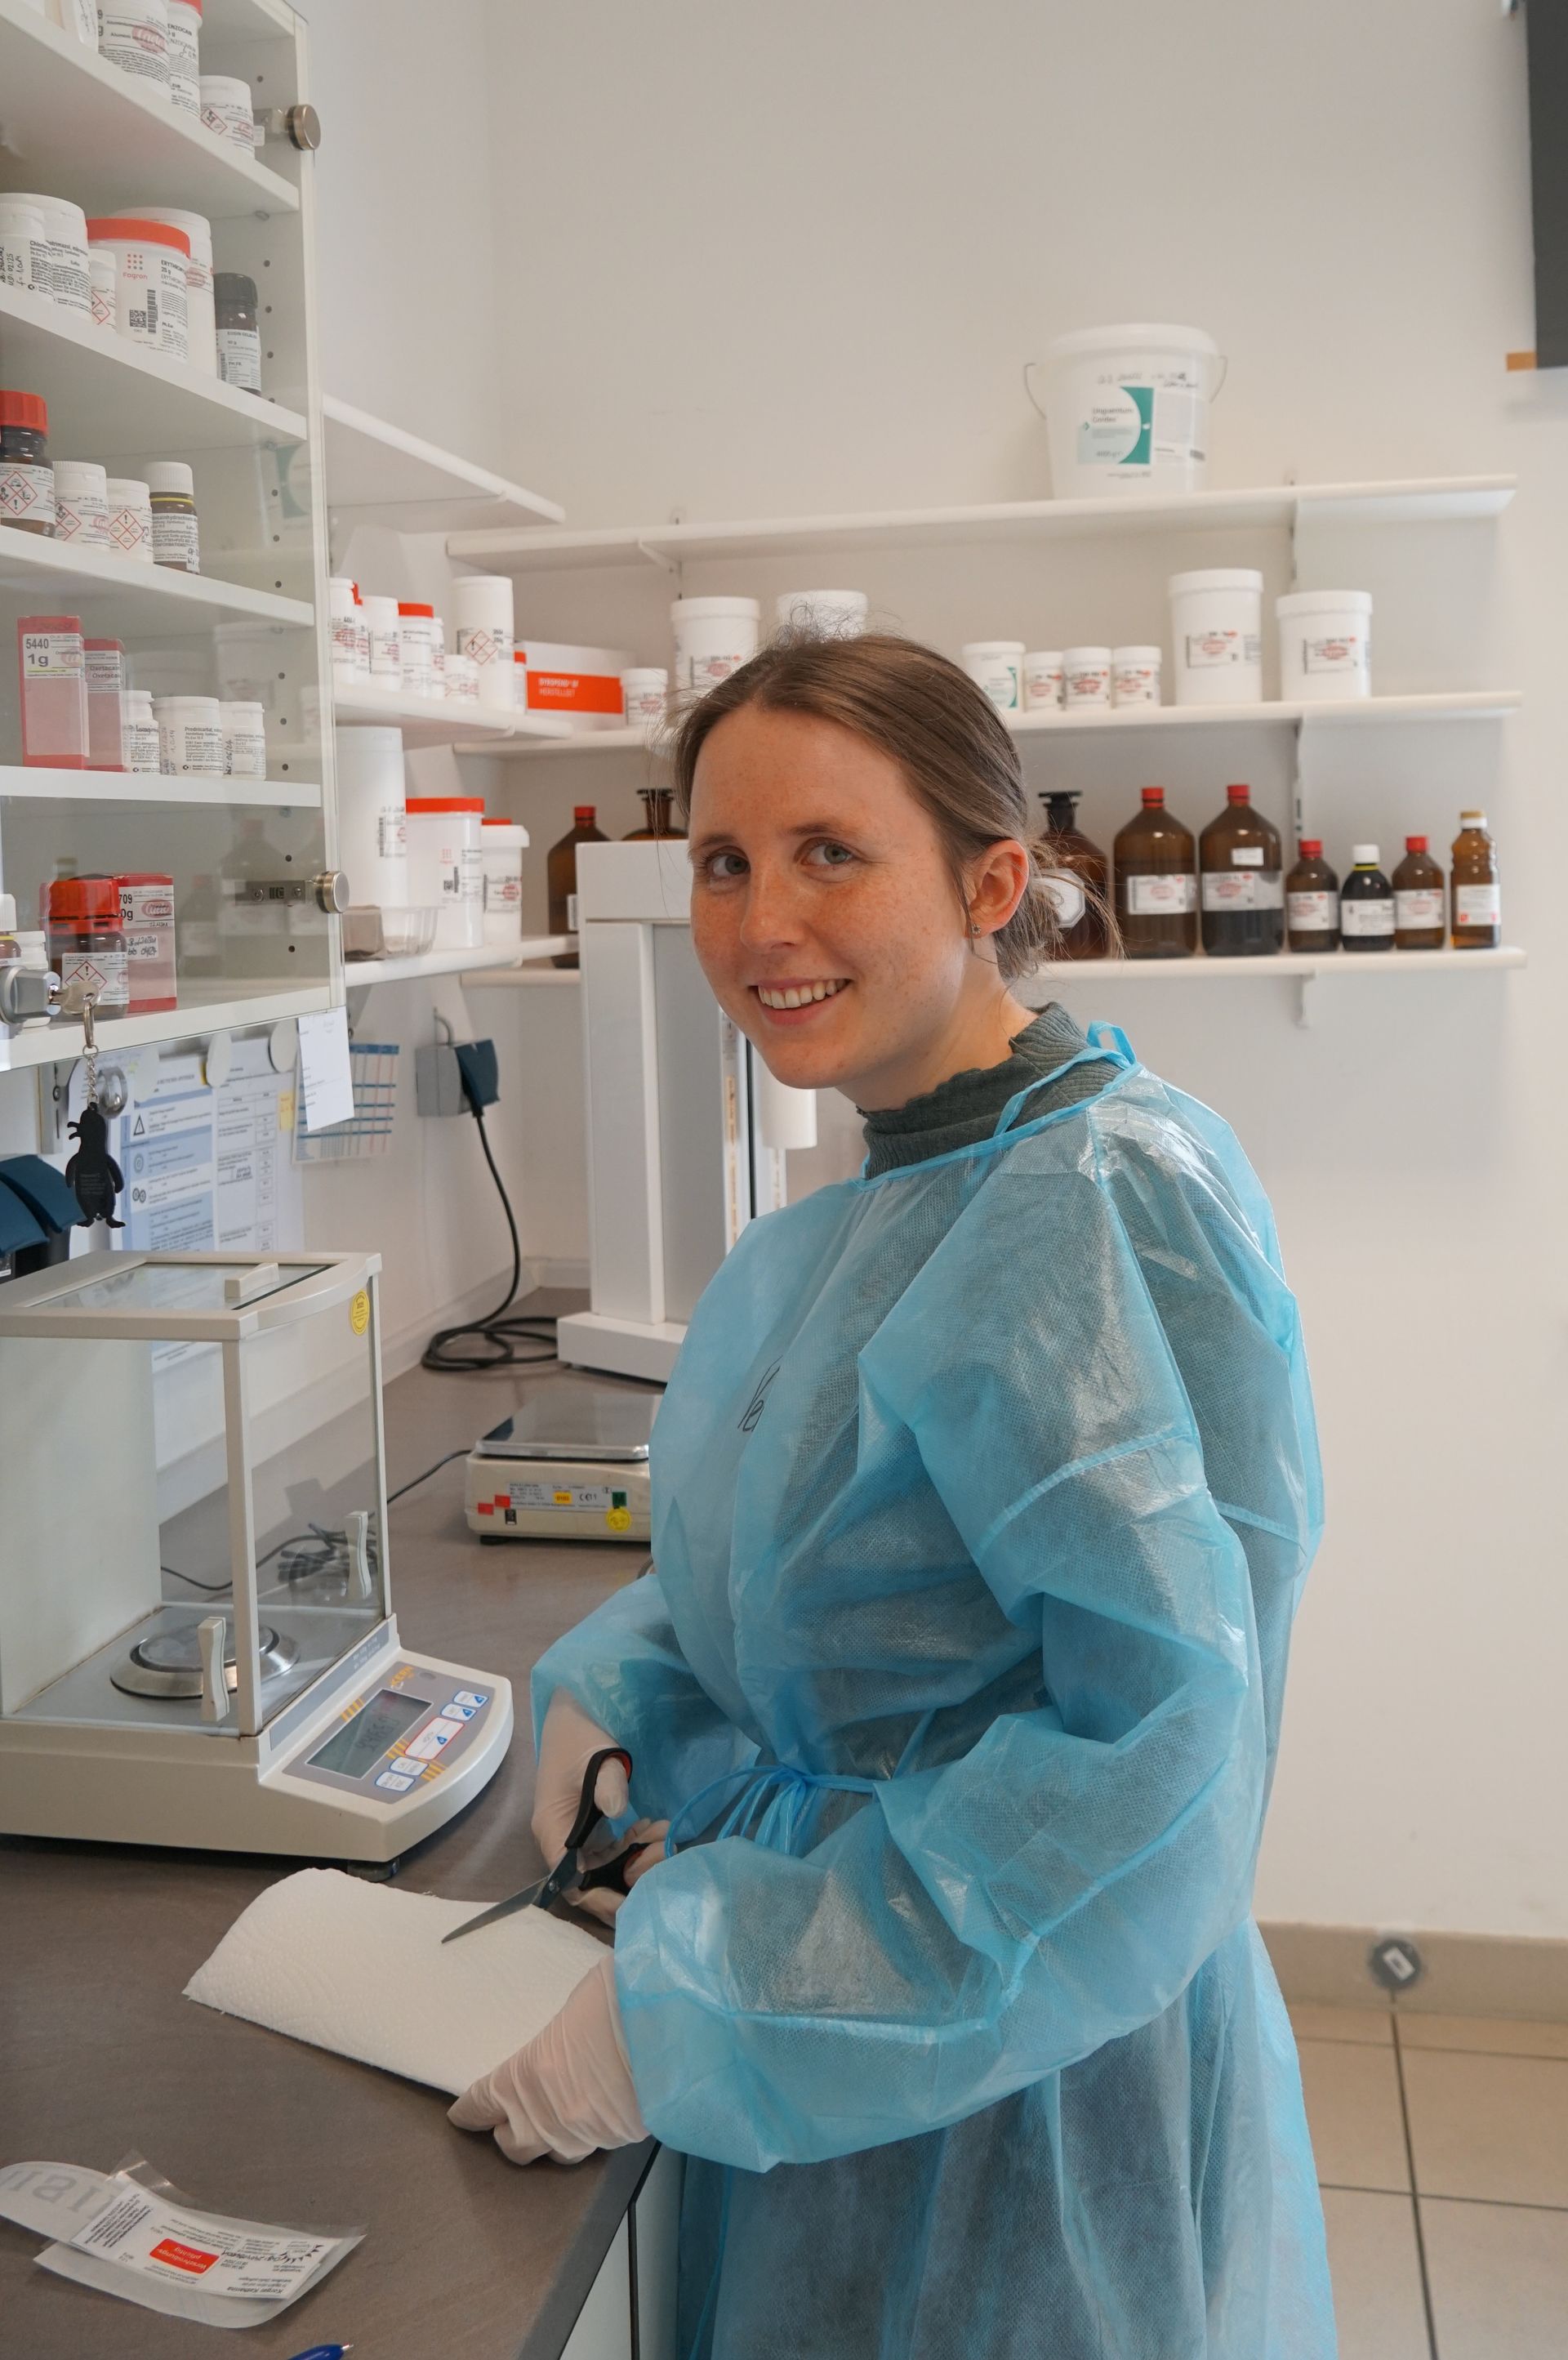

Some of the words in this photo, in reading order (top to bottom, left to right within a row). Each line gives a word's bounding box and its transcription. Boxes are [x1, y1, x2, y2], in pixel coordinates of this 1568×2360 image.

[122, 272, 149, 280] Fagron
[25, 638, 49, 649] 5440
[27, 654, 49, 667] 1g
